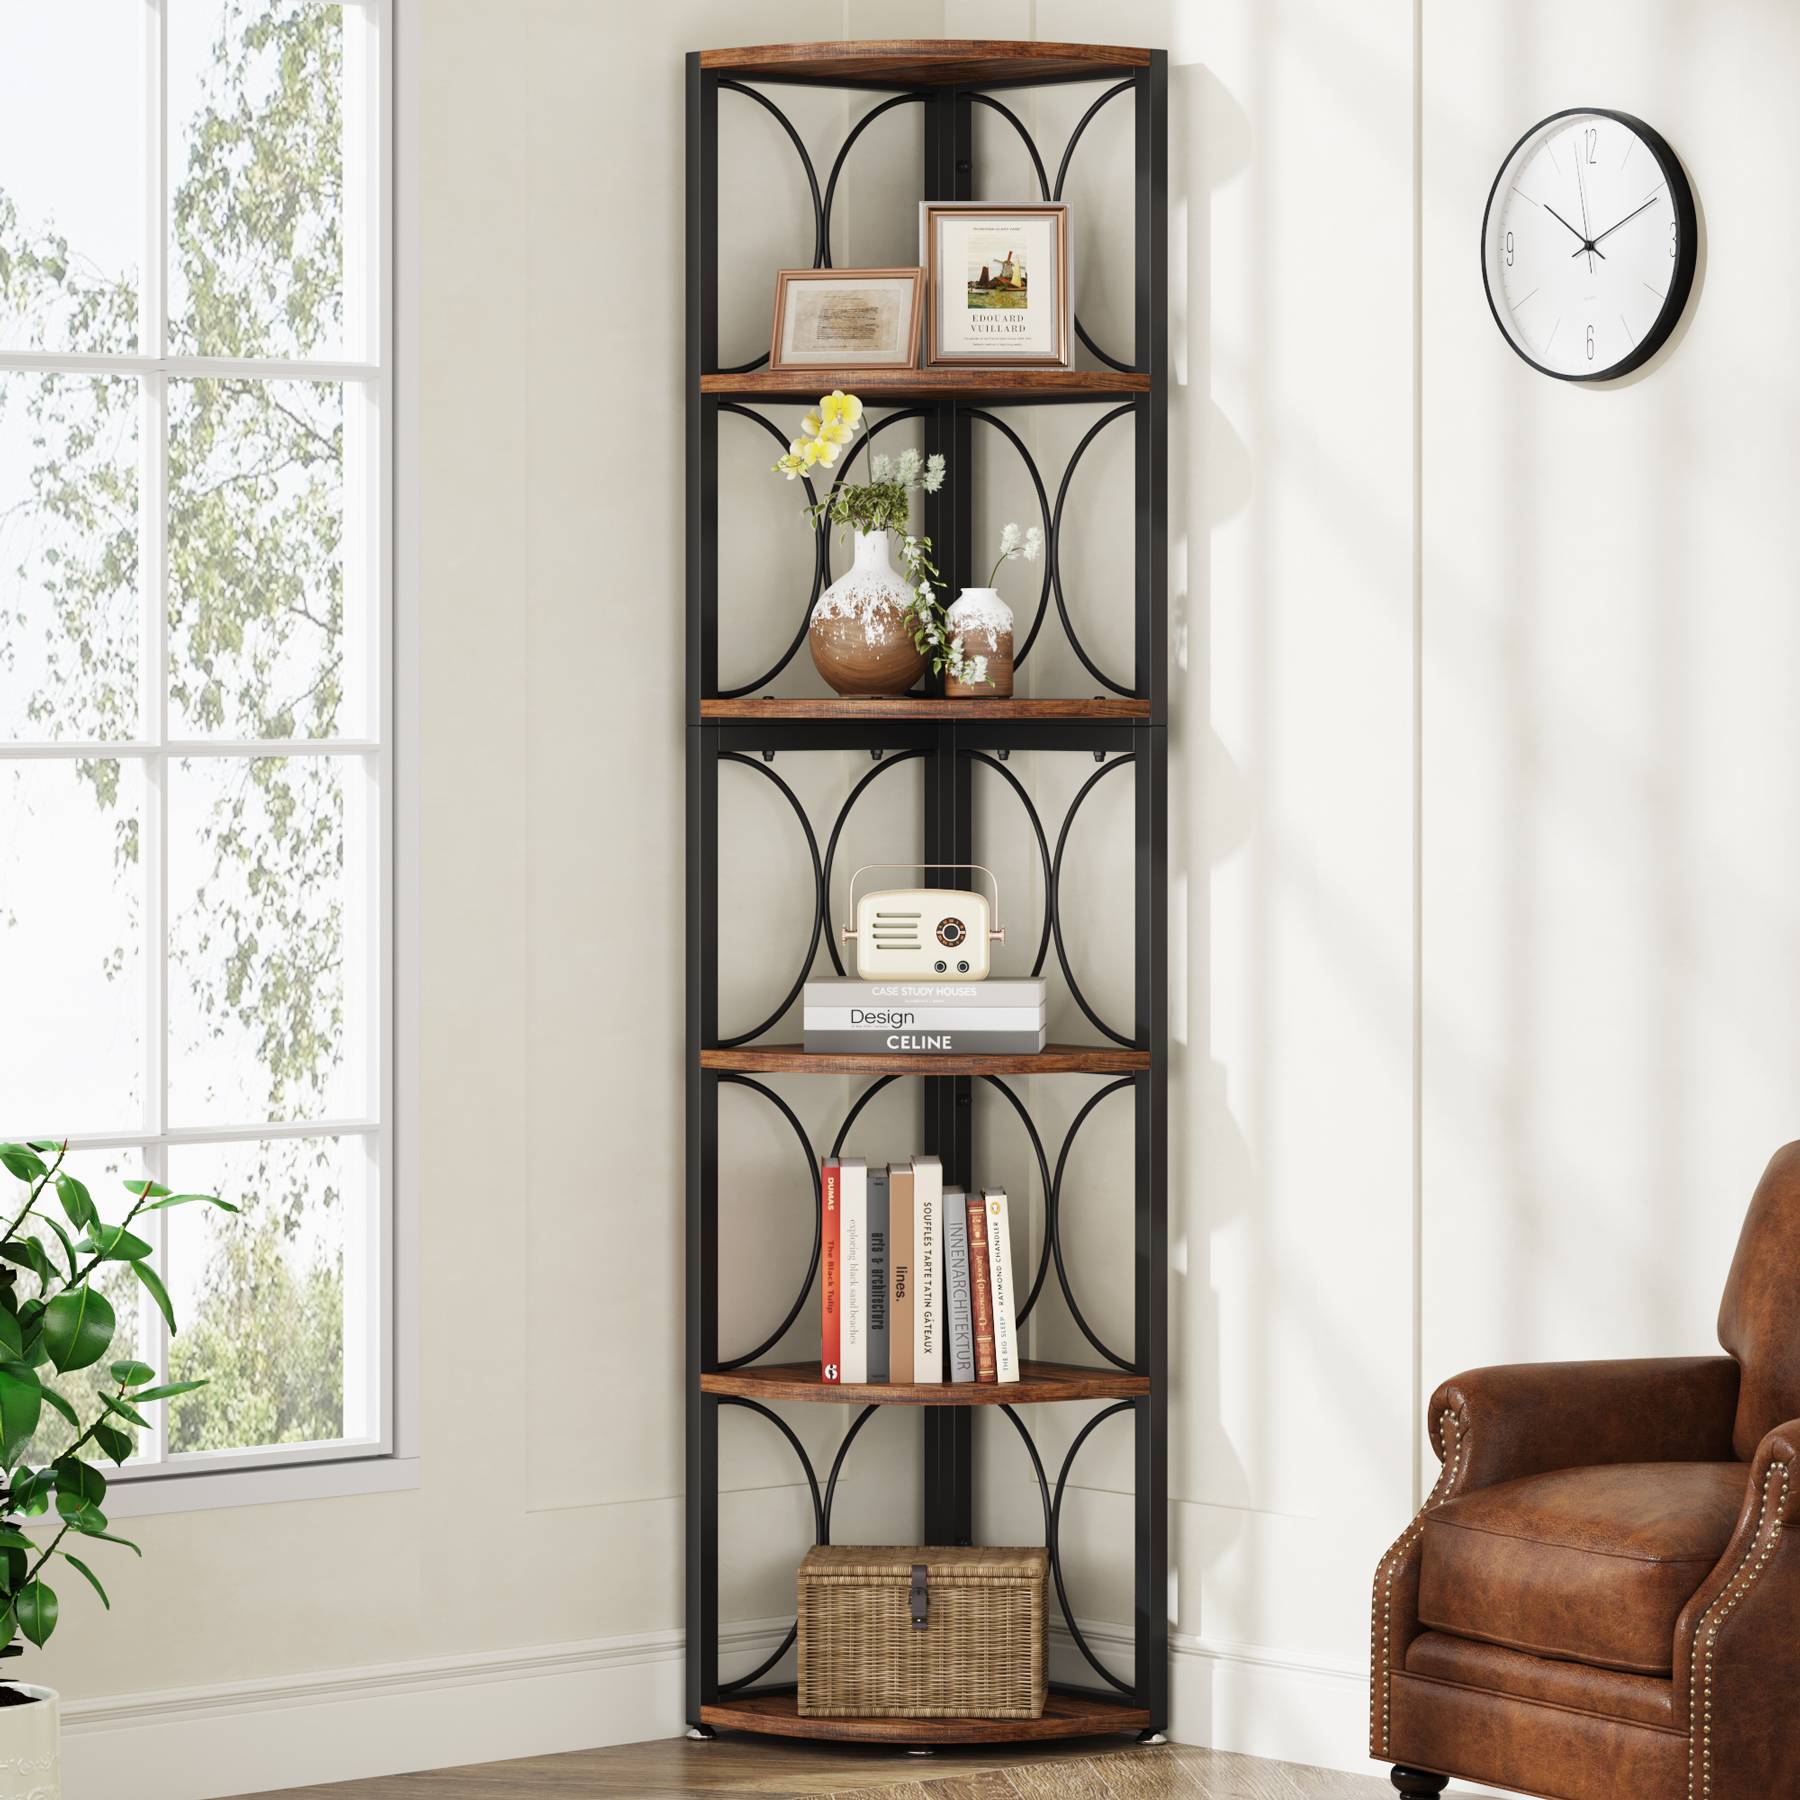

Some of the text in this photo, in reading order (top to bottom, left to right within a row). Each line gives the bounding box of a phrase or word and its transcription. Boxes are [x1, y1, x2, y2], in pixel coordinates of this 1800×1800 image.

[1584, 128, 1597, 165] 12
[1506, 231, 1514, 267] 9
[970, 324, 1026, 333] VUILLARD
[972, 314, 1024, 323] EDOUARD
[1586, 324, 1594, 360] 6
[871, 986, 977, 997] CASE STUDY HOUSES
[850, 1009, 915, 1029] Design
[886, 1035, 952, 1050] CELINE
[827, 1177, 835, 1211] DUMAS
[871, 1232, 886, 1252] arts
[993, 1222, 1001, 1263] CHANDLER
[826, 1240, 835, 1314] The Black Tulip
[847, 1219, 860, 1344] exploring black sand beaches
[923, 1250, 933, 1278] TARTE
[871, 1269, 886, 1330] architecture
[896, 1266, 908, 1302] lines.
[923, 1280, 933, 1308] TATIN
[949, 1222, 971, 1371] INNENARCHITEKTUR
[996, 1265, 1004, 1306] RAYMOND
[999, 1317, 1007, 1338] SLEEP
